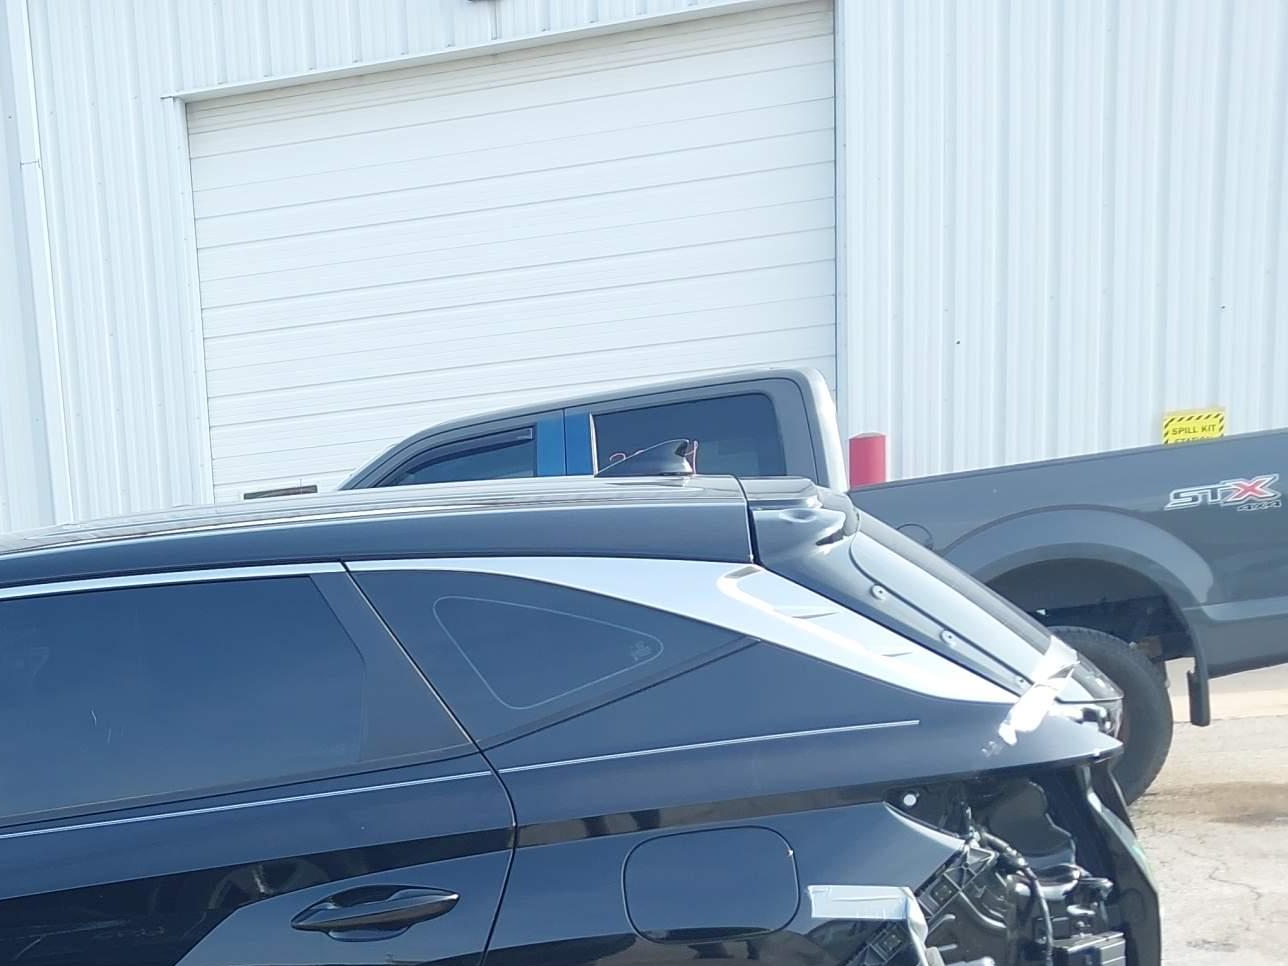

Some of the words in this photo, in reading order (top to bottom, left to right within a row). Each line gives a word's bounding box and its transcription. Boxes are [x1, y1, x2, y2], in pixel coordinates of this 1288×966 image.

[1171, 426, 1199, 436] SPILL
[1201, 424, 1217, 433] KIT
[1163, 473, 1282, 511] STX
